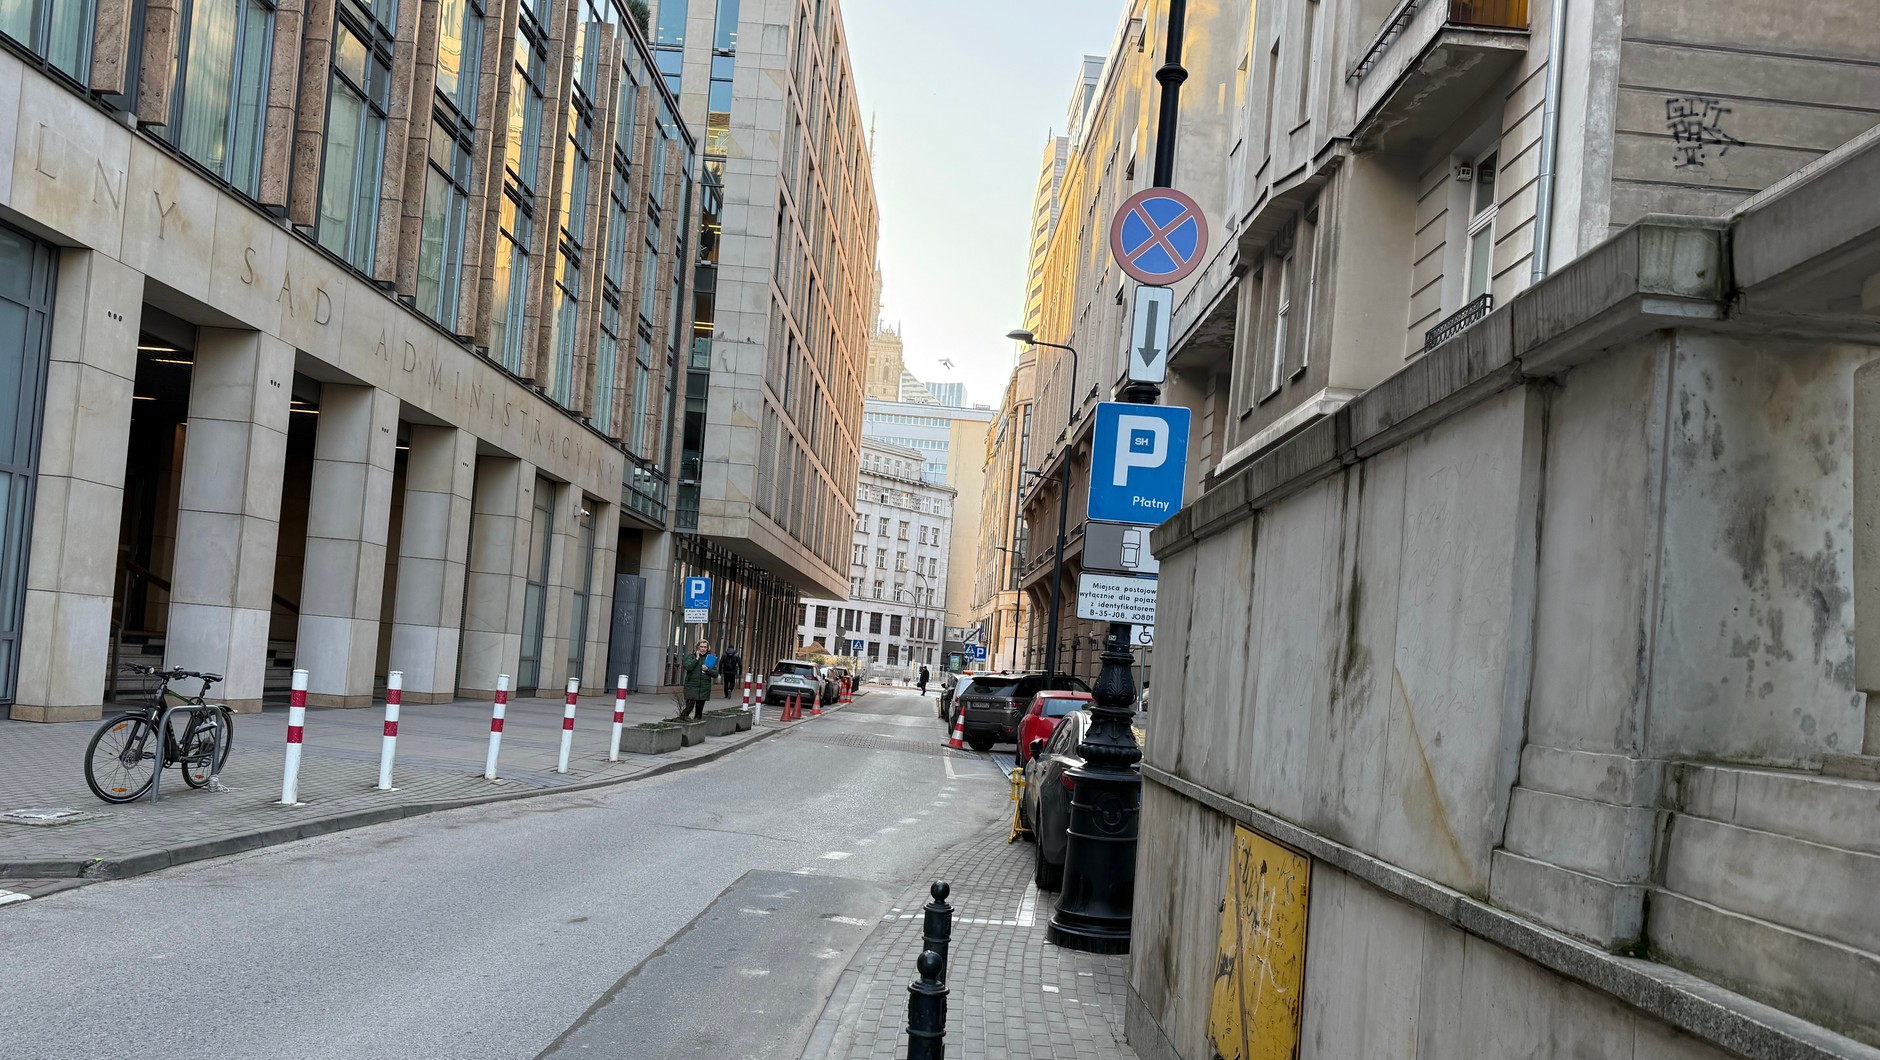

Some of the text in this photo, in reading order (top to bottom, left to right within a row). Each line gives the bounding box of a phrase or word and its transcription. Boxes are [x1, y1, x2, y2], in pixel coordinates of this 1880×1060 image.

[35, 122, 615, 484] LNY SĄD ADMINISTRACYJNY
[1135, 437, 1149, 446] SH
[1112, 414, 1170, 487] P
[1132, 495, 1169, 512] Płatny
[690, 579, 706, 599] P
[1092, 582, 1120, 591] Miejsca
[1079, 591, 1115, 600] wyłącznie
[1098, 600, 1155, 612] identyfikatorem
[976, 647, 984, 657] P
